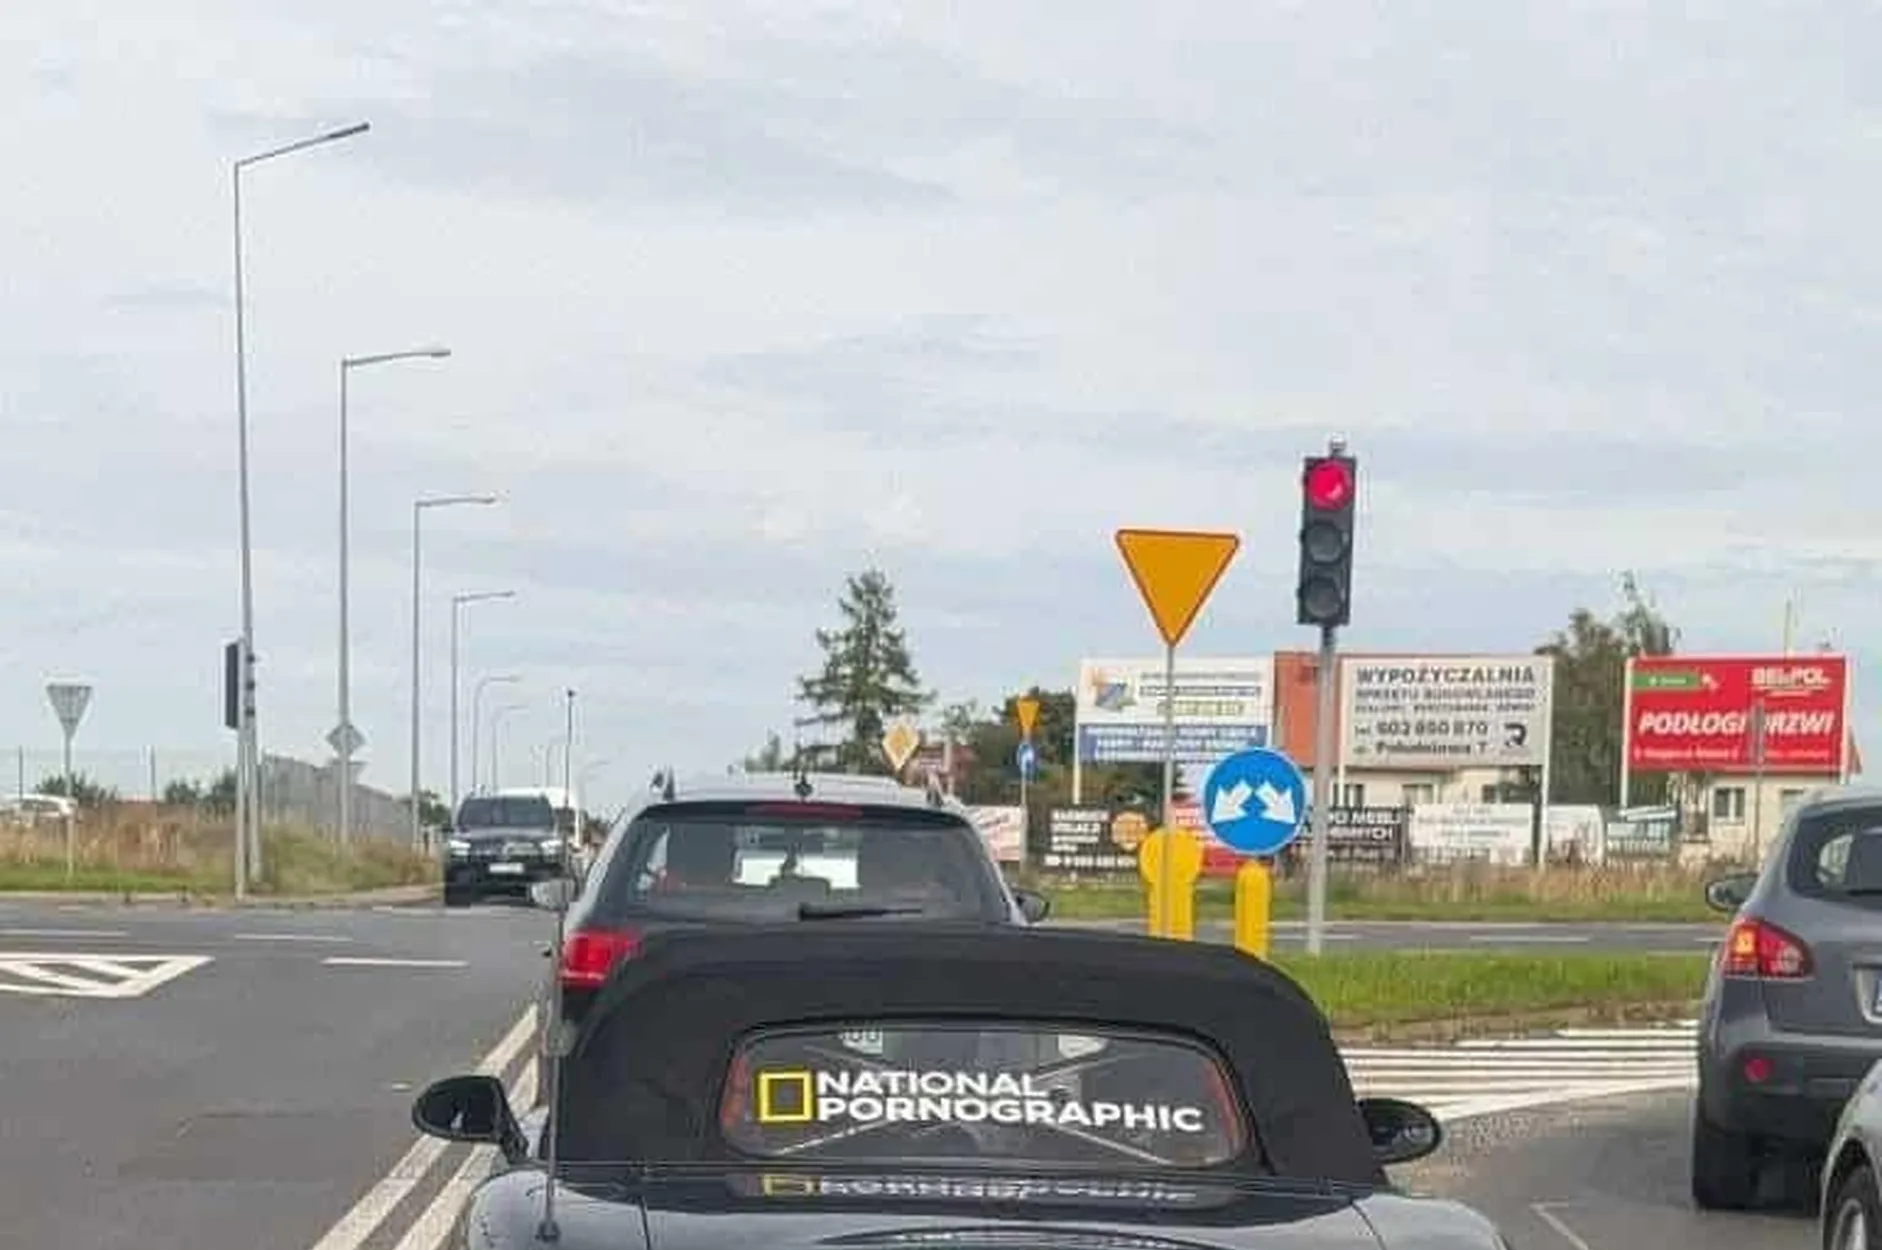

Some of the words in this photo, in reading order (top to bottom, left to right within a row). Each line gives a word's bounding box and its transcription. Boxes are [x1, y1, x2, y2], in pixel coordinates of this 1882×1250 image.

[1356, 666, 1535, 684] WYPOŻYCZALNIA
[1639, 712, 1746, 735] PODŁOGI
[1763, 712, 1834, 735] RZWI
[816, 1070, 1049, 1097] NATIONAL
[816, 1097, 1204, 1133] PORNOGRAPHIC
